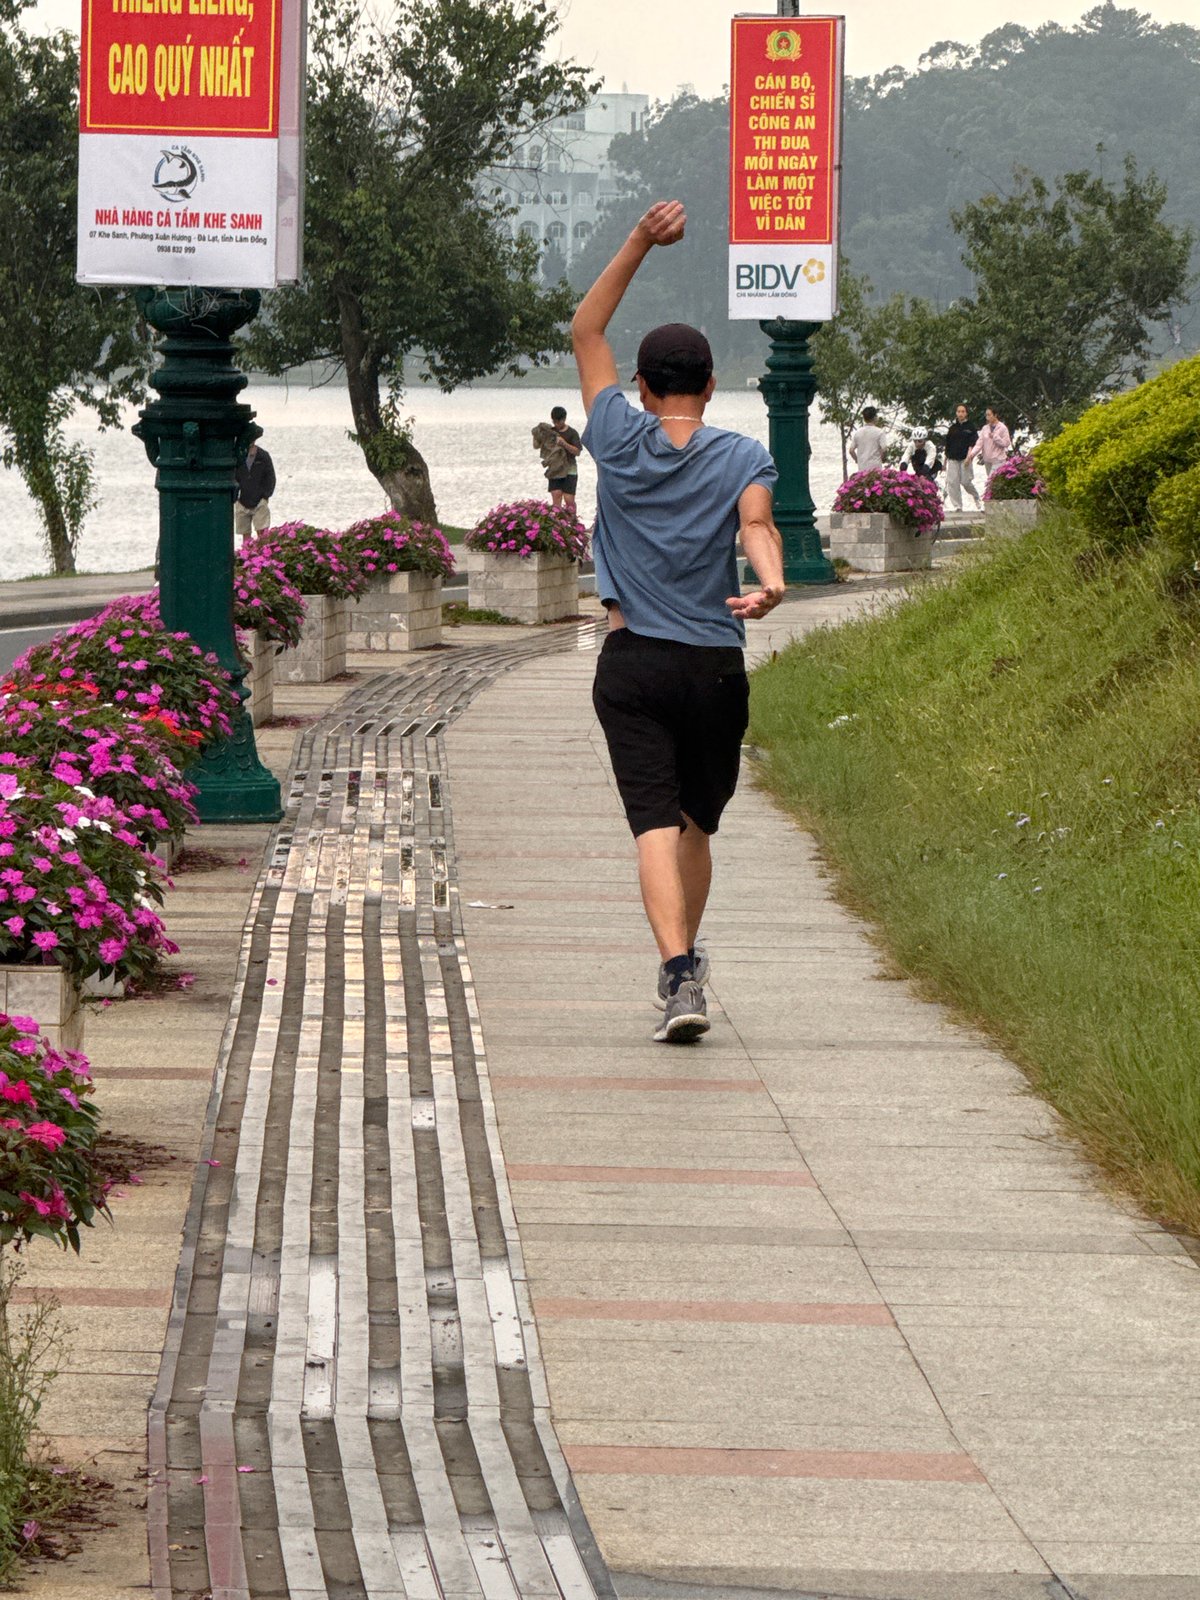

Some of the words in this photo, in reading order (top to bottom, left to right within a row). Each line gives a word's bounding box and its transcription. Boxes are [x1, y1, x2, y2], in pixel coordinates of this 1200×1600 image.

[108, 43, 148, 95] CAO
[154, 34, 194, 101] QUÝ
[200, 27, 255, 98] NHẤT
[754, 72, 786, 90] CÁN
[790, 72, 815, 92] BỘ,
[750, 91, 795, 110] CHIẾN
[800, 92, 816, 110] SĨ
[748, 113, 790, 130] CÔNG
[794, 115, 816, 130] AN
[753, 135, 776, 150] THI
[781, 135, 811, 150] ĐUA
[744, 151, 773, 170] MỖI
[778, 152, 818, 170] NGÀY
[746, 173, 778, 191] LÀM
[783, 173, 816, 192] MỘT
[749, 193, 782, 213] VIỆC
[787, 190, 813, 211] TỐT
[95, 206, 119, 226] NHÀ
[122, 206, 153, 227] HÀNG
[157, 208, 172, 228] CÁ
[203, 212, 227, 229] KHE
[230, 213, 262, 230] SANH
[756, 212, 770, 230] VÌ
[775, 214, 806, 230] DÂN
[736, 264, 803, 290] BIDV
